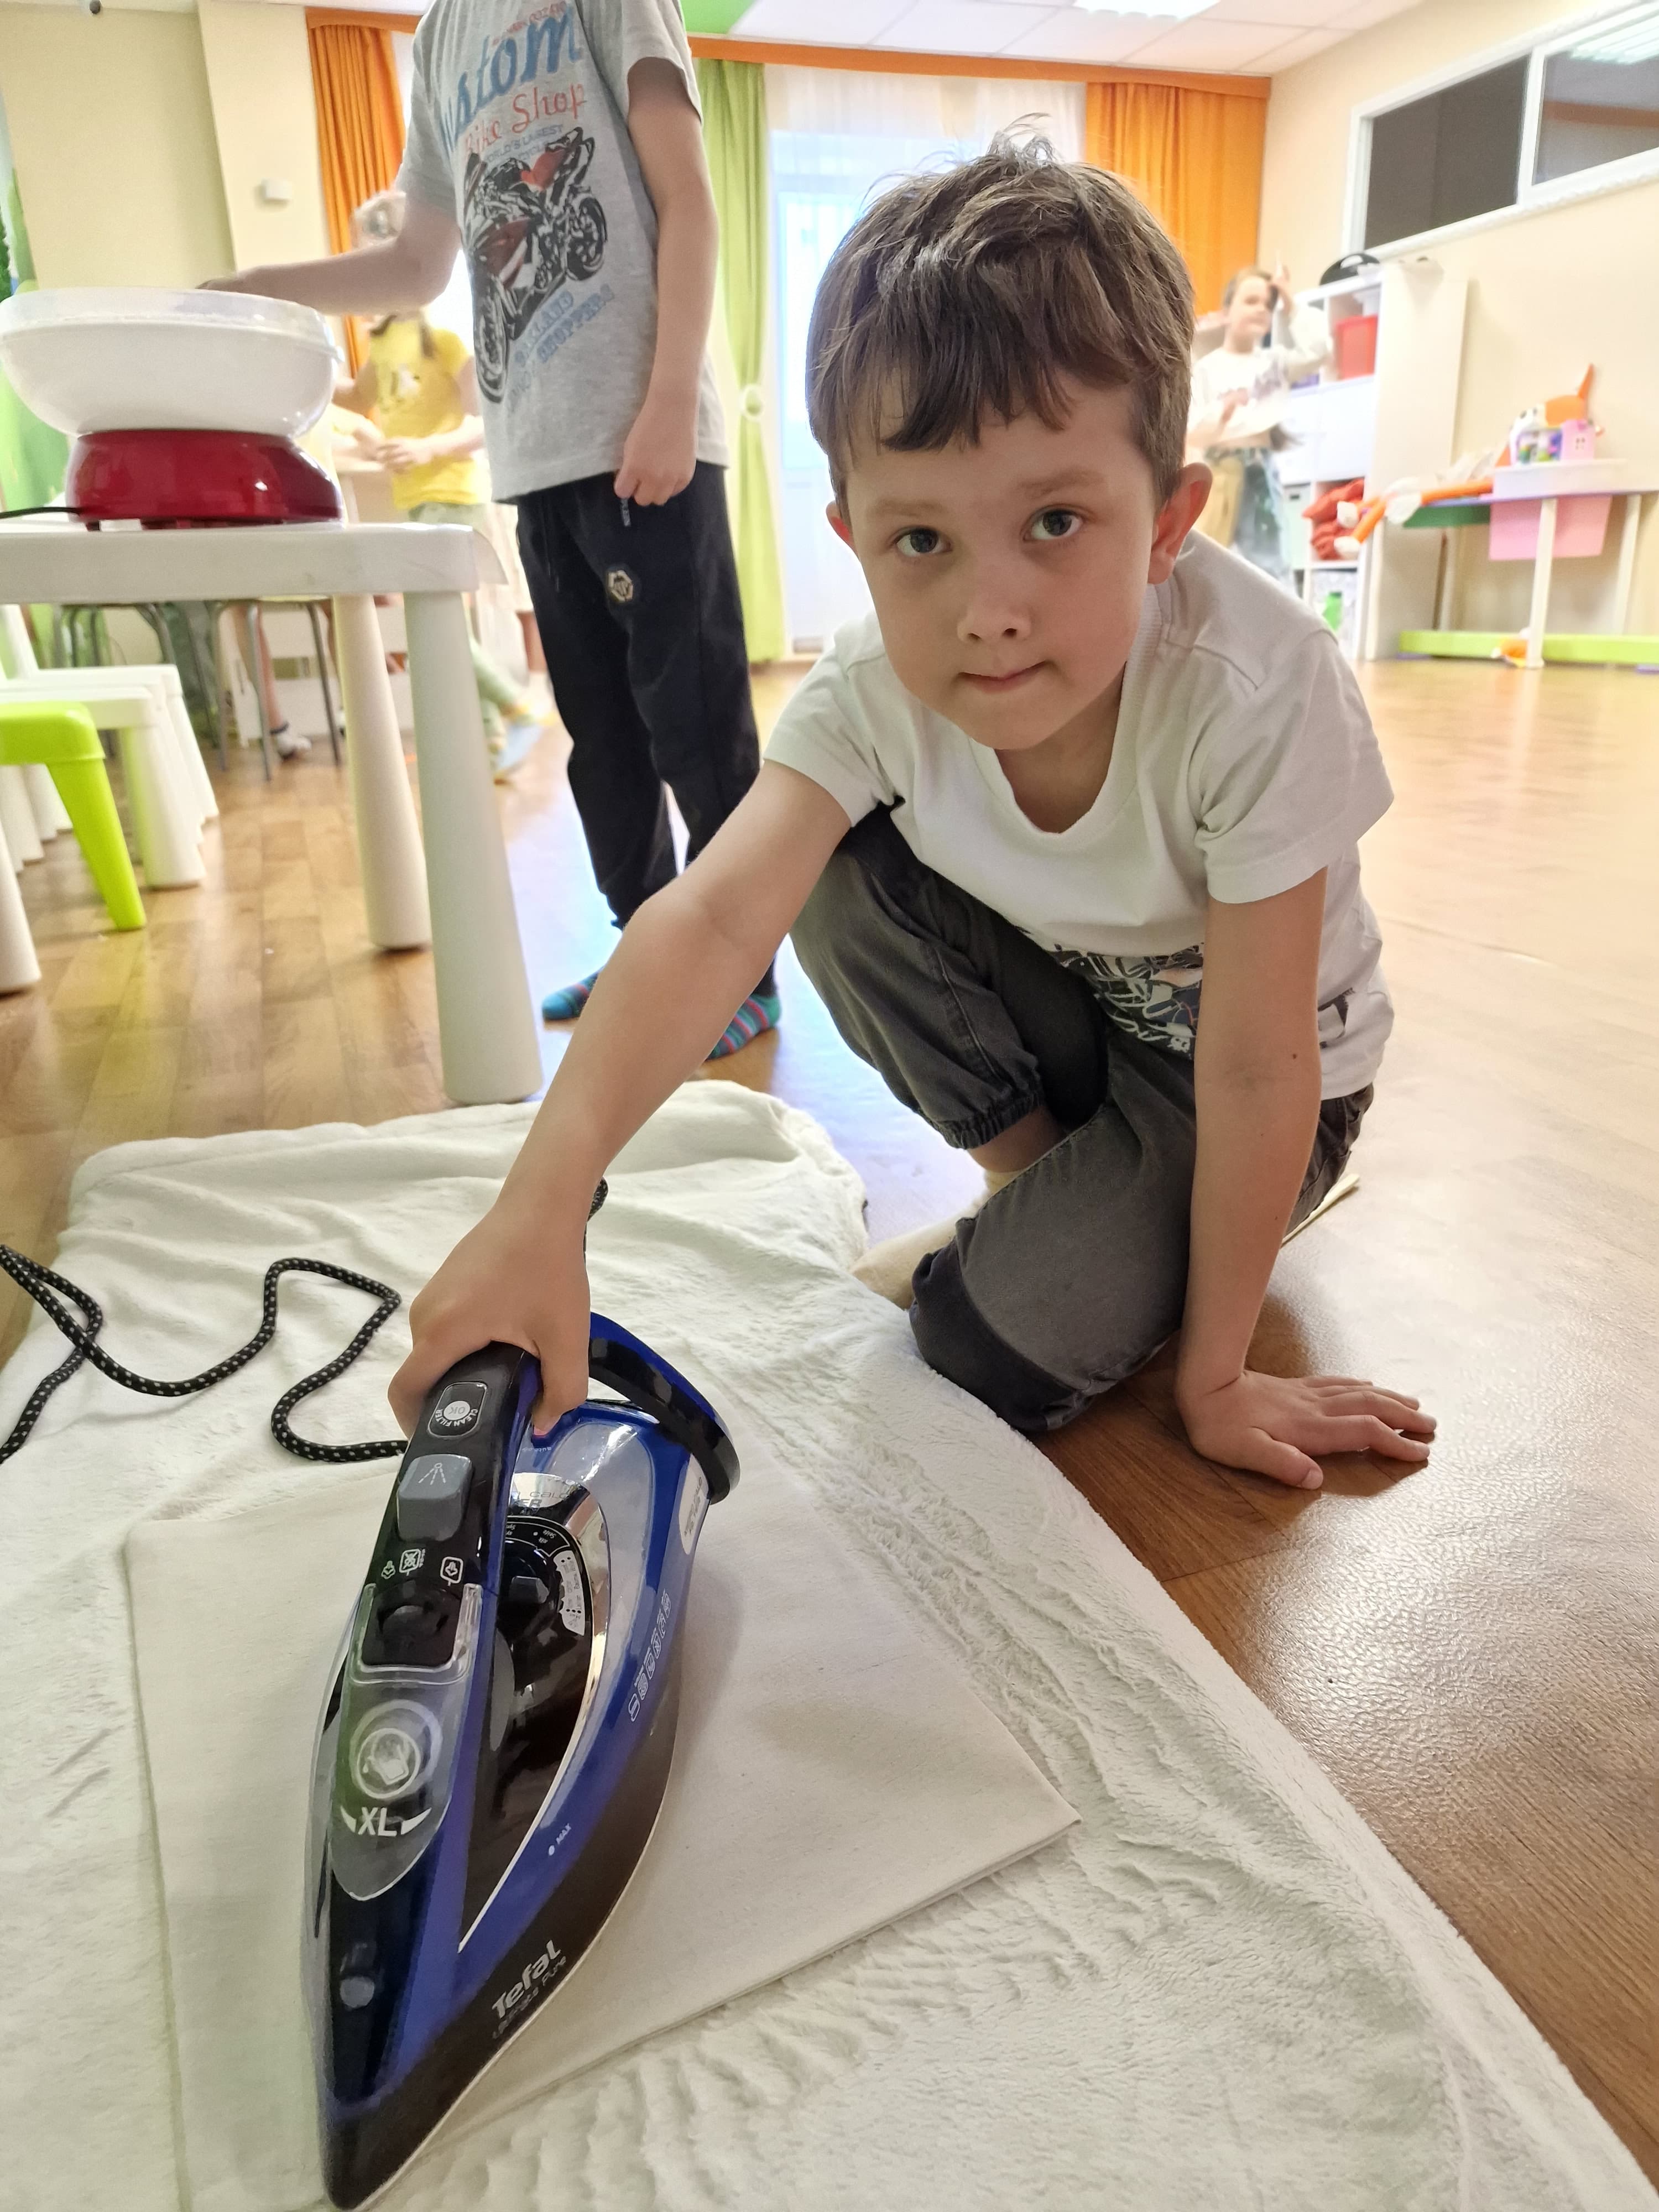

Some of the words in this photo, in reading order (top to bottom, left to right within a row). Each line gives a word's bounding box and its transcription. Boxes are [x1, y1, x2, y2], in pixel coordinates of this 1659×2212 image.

[512, 84, 587, 133] Shop
[435, 1408, 452, 1427] FILTER
[448, 1406, 465, 1415] OK
[453, 1408, 478, 1427] CLEAN
[358, 1806, 398, 1837] XL
[492, 1939, 562, 2019] Tefal
